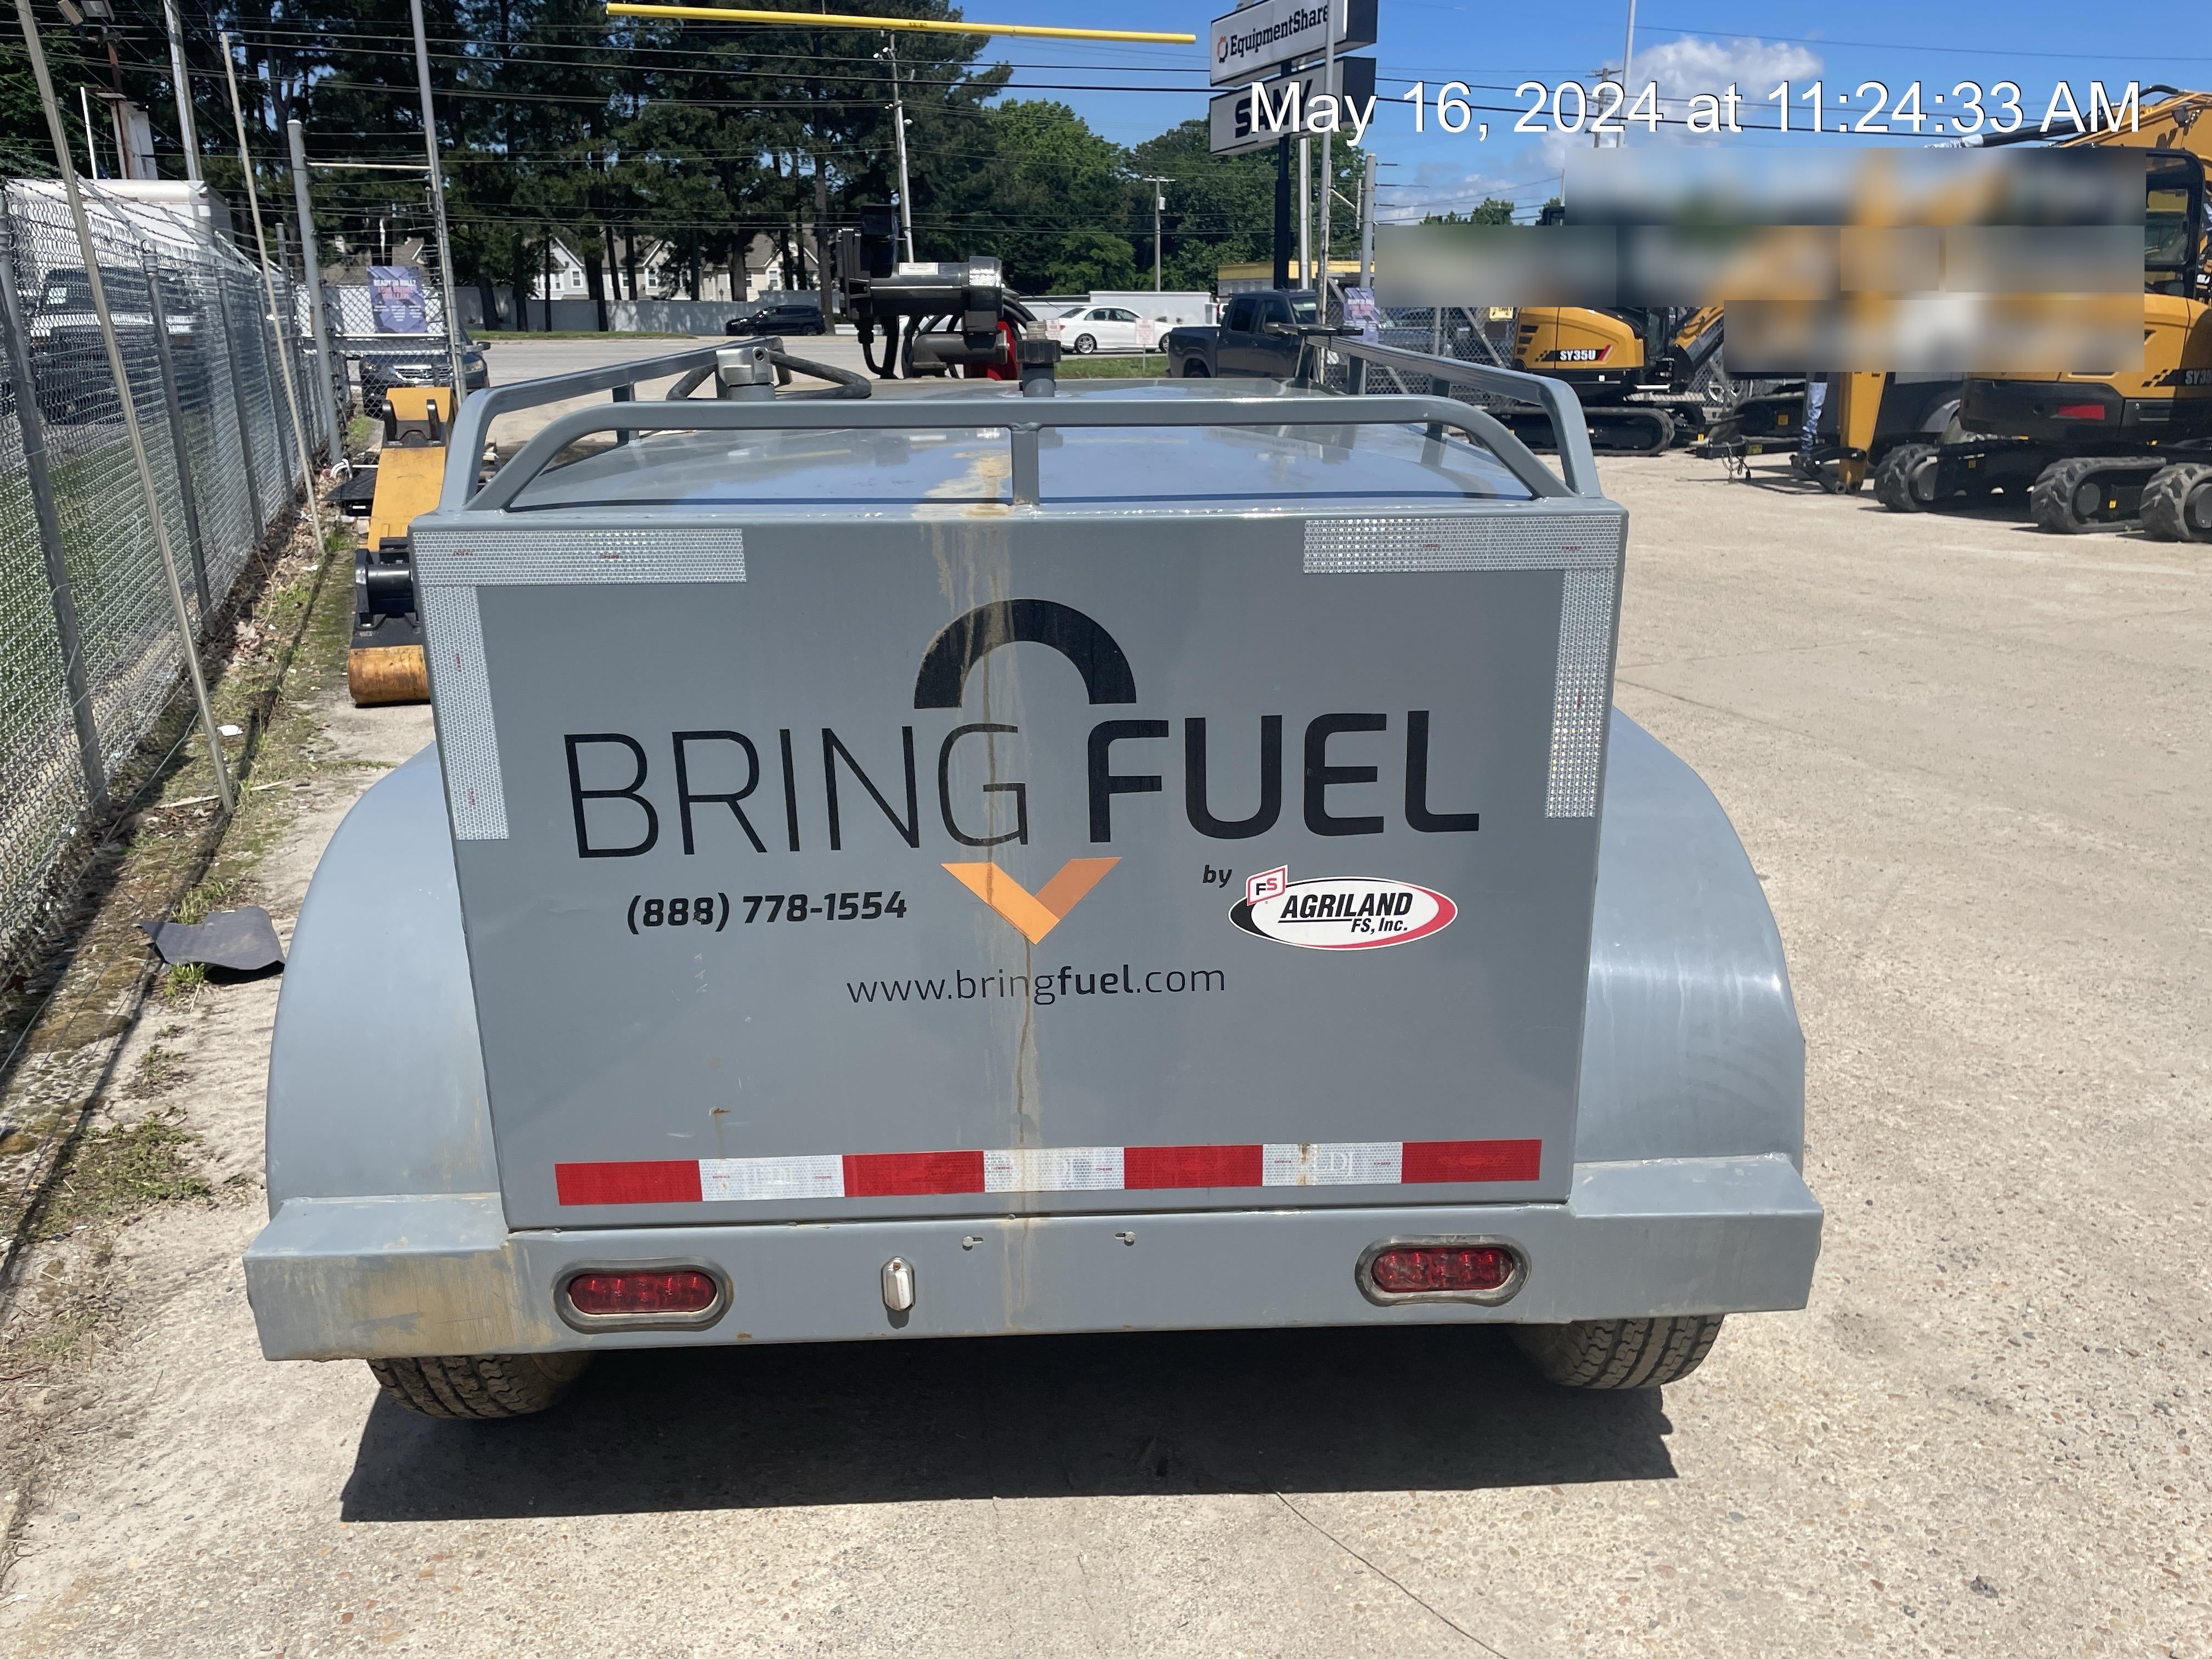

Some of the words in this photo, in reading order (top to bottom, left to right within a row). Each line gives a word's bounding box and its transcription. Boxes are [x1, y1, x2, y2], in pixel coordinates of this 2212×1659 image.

[1230, 4, 1328, 58] EquipmentShare
[1560, 349, 1596, 361] SY35U
[563, 723, 1029, 859] BRING
[1087, 710, 1480, 843] FUEL
[1202, 864, 1233, 889] by
[1255, 877, 1278, 896] FS
[627, 892, 730, 935] (888)
[743, 890, 907, 924] 778-1554
[1280, 891, 1414, 919] AGRILAND
[1351, 918, 1376, 935] FS,
[1378, 917, 1408, 932] Inc.
[847, 964, 1225, 1005] www.bringfuel.com
